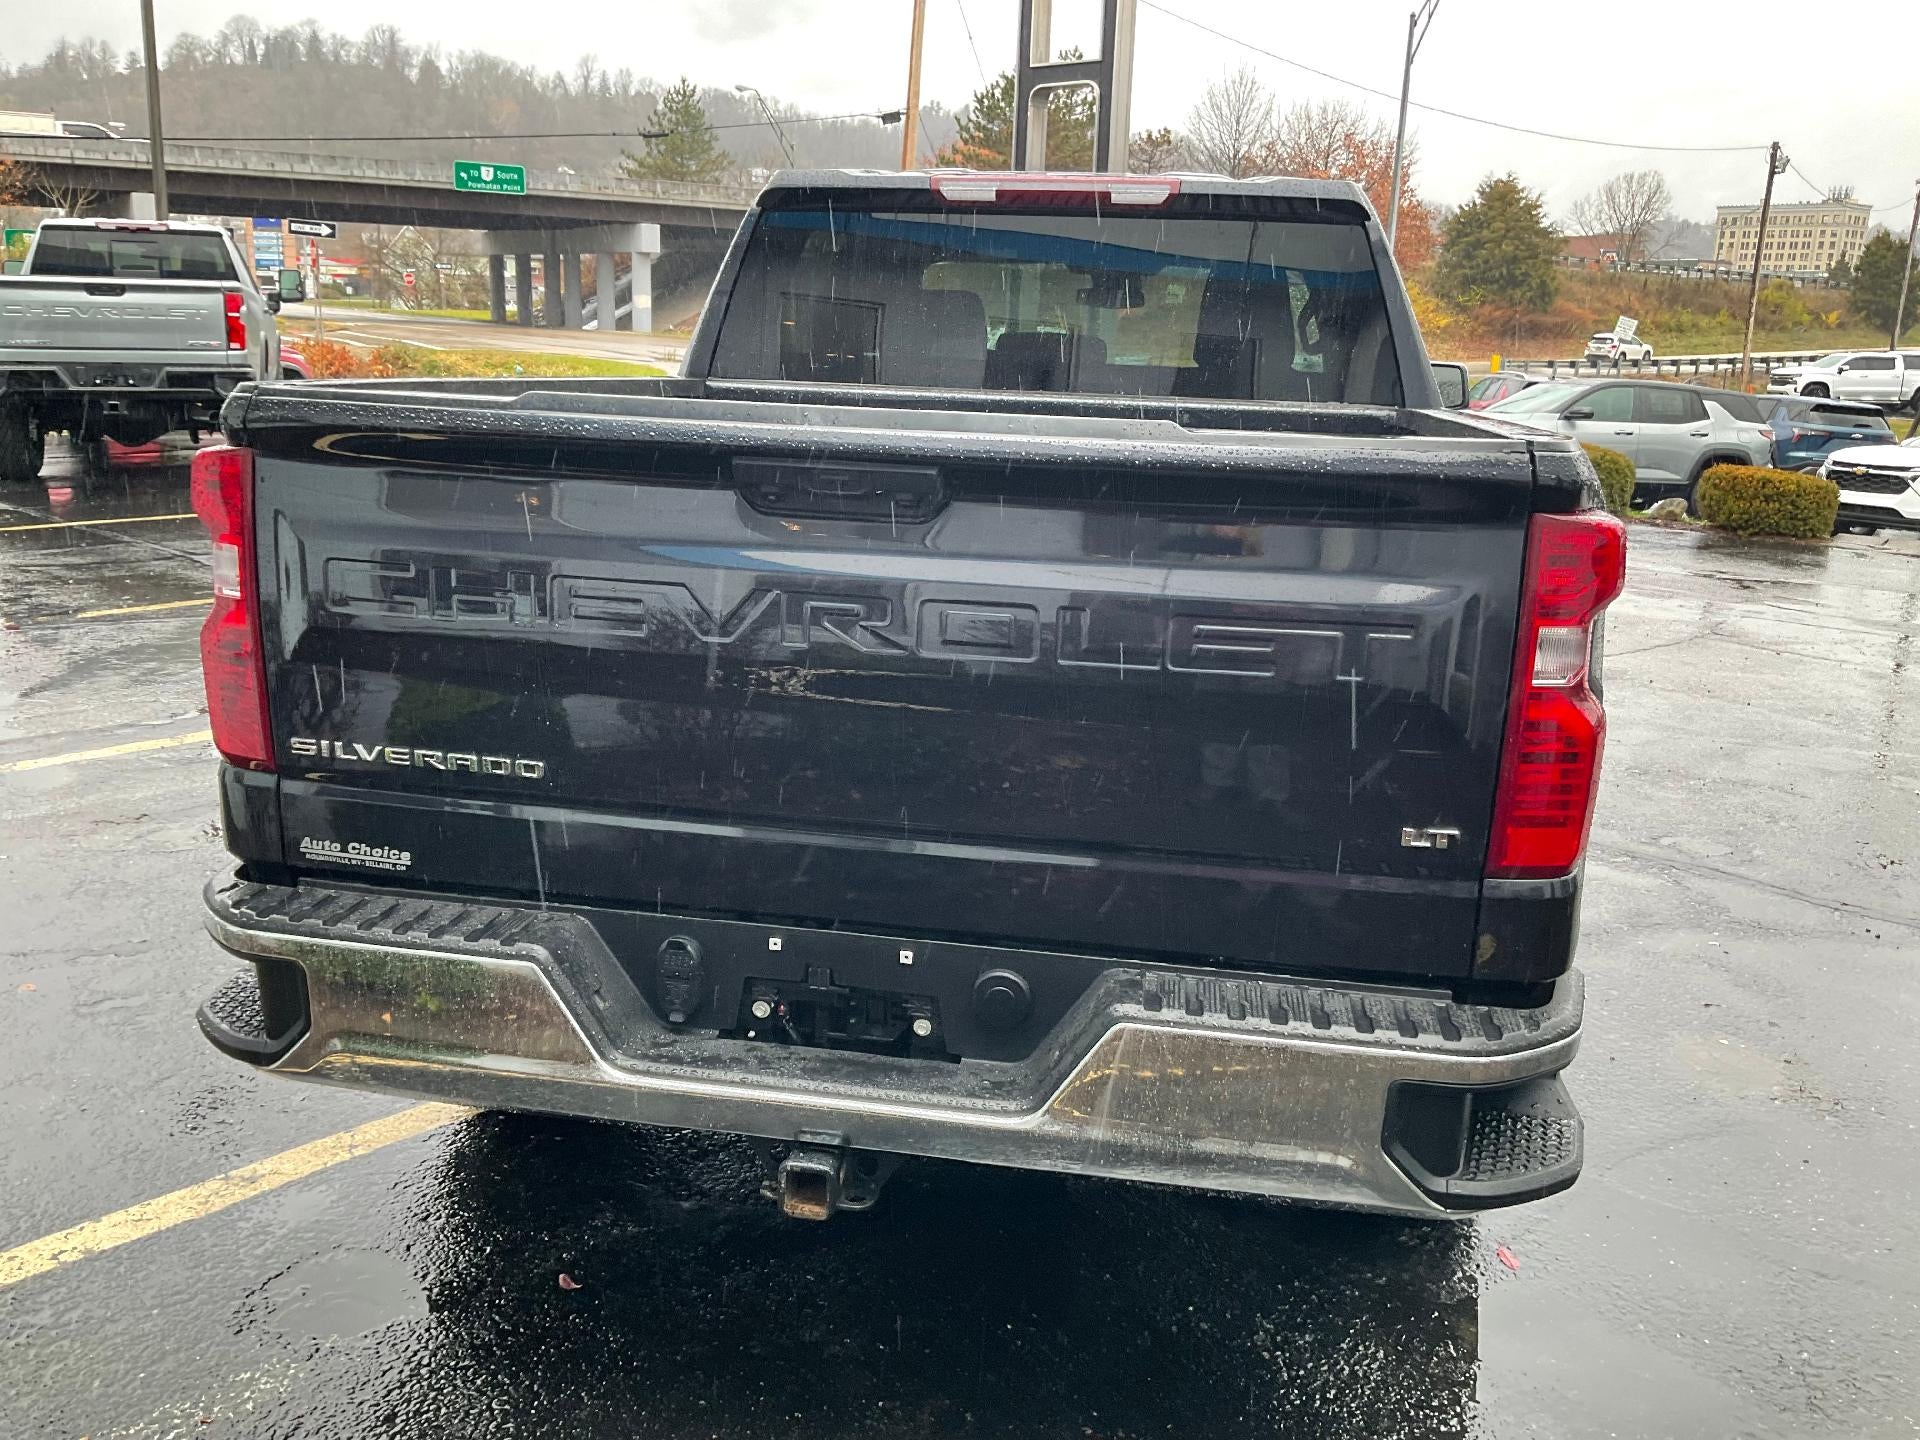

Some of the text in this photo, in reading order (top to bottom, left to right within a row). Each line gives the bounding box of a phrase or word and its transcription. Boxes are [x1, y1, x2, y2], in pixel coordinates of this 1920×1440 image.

[467, 181, 501, 190] Powhatan
[496, 170, 518, 180] SOUTH
[2, 304, 209, 320] CHEVROLET
[322, 556, 1416, 681] CHEVROLET
[290, 736, 545, 779] SILVERADO
[299, 836, 411, 861] Auto Choice
[1400, 826, 1460, 849] LT
